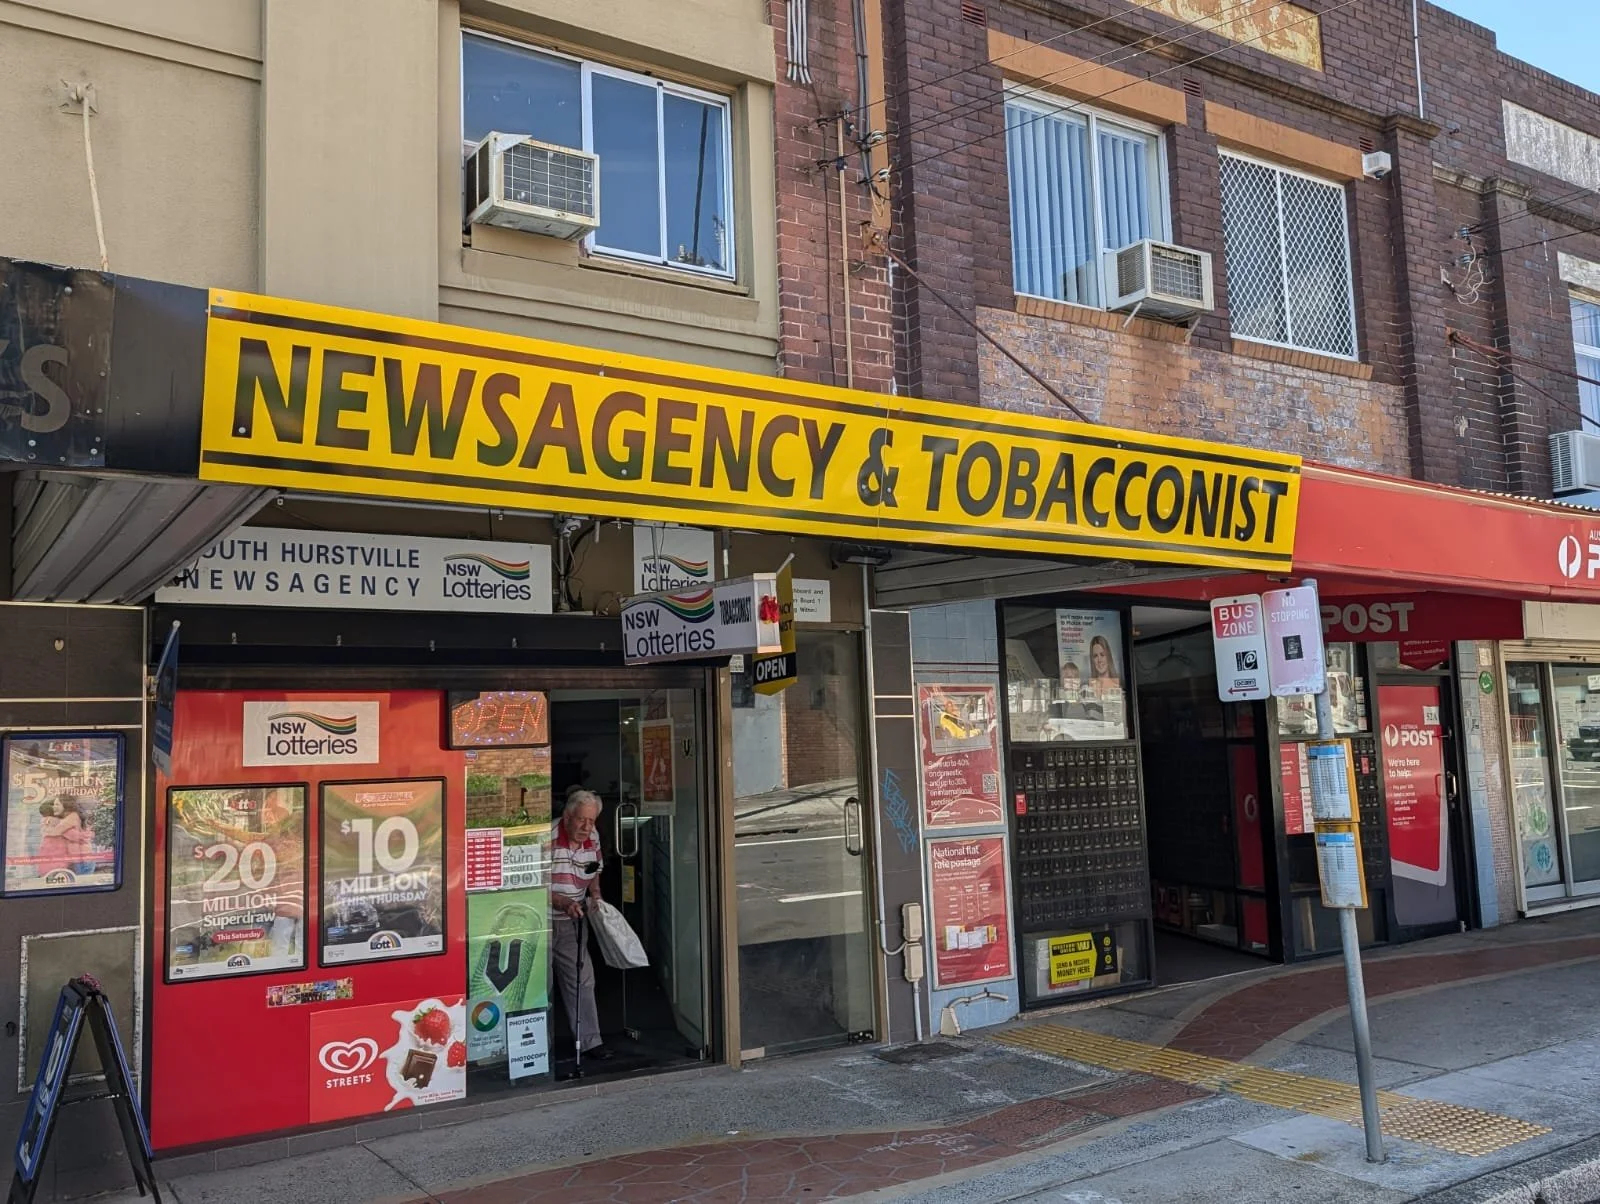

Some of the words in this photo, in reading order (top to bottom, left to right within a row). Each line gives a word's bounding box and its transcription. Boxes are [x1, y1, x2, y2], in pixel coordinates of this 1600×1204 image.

[232, 337, 846, 499] NEWSAGENCY
[857, 428, 898, 507] &
[921, 435, 1288, 543] TOBACCONIST
[202, 540, 268, 561] UTH
[281, 543, 420, 569] HURSTVILLE
[446, 563, 481, 576] NSW
[183, 568, 420, 597] NEWSAGENCY
[443, 577, 531, 600] Lotteries
[1282, 596, 1296, 607] NO
[719, 596, 752, 626] TOBACCONIST
[1220, 605, 1254, 621] BUS
[1271, 609, 1310, 623] STOPPING
[1321, 602, 1414, 634] POST
[625, 609, 660, 630] NSW
[1222, 621, 1256, 637] ZONE
[624, 628, 716, 658] Lotteries
[756, 657, 787, 681] OPEN
[454, 703, 544, 731] OPEN
[270, 722, 306, 734] NSW
[267, 735, 358, 756] Lotteries
[1401, 730, 1434, 747] POST
[48, 776, 104, 788] MILLION
[223, 799, 257, 811] Lotto
[340, 815, 420, 875] $10
[933, 846, 965, 858] National
[503, 853, 533, 864] eturn
[951, 858, 981, 869] postage
[193, 841, 277, 893] $20
[340, 871, 428, 896] MILLION
[203, 892, 277, 913] MILLION
[368, 892, 428, 906] THURSDAY
[203, 911, 277, 930] Superdraw
[216, 933, 230, 941] This
[231, 930, 261, 940] Saturday
[1056, 968, 1077, 978] MONEY
[509, 1016, 545, 1026] PHOTOCOPY
[511, 1052, 547, 1063] PHOTOCOPY
[326, 1074, 372, 1089] STREETS
